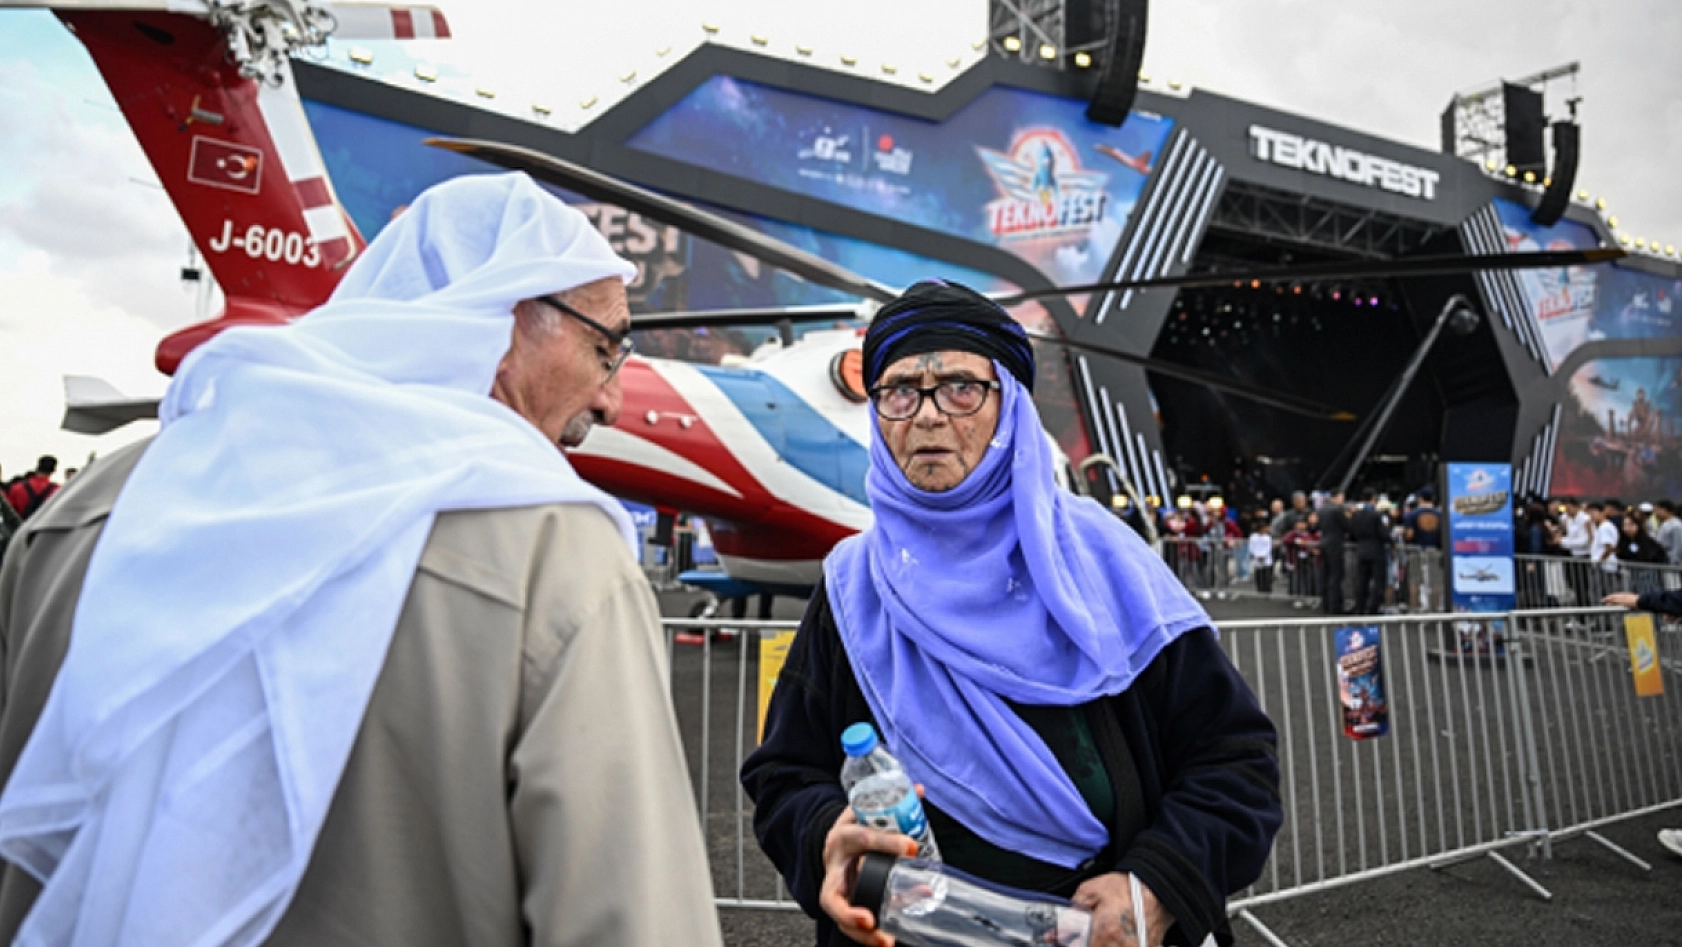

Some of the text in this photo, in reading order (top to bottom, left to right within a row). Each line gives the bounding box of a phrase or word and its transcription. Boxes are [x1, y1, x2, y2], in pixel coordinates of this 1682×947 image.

[1249, 124, 1440, 200] TEKNOFEST
[577, 205, 679, 253] EST
[986, 193, 1107, 236] TEKNOFEST
[209, 219, 321, 268] J-6003
